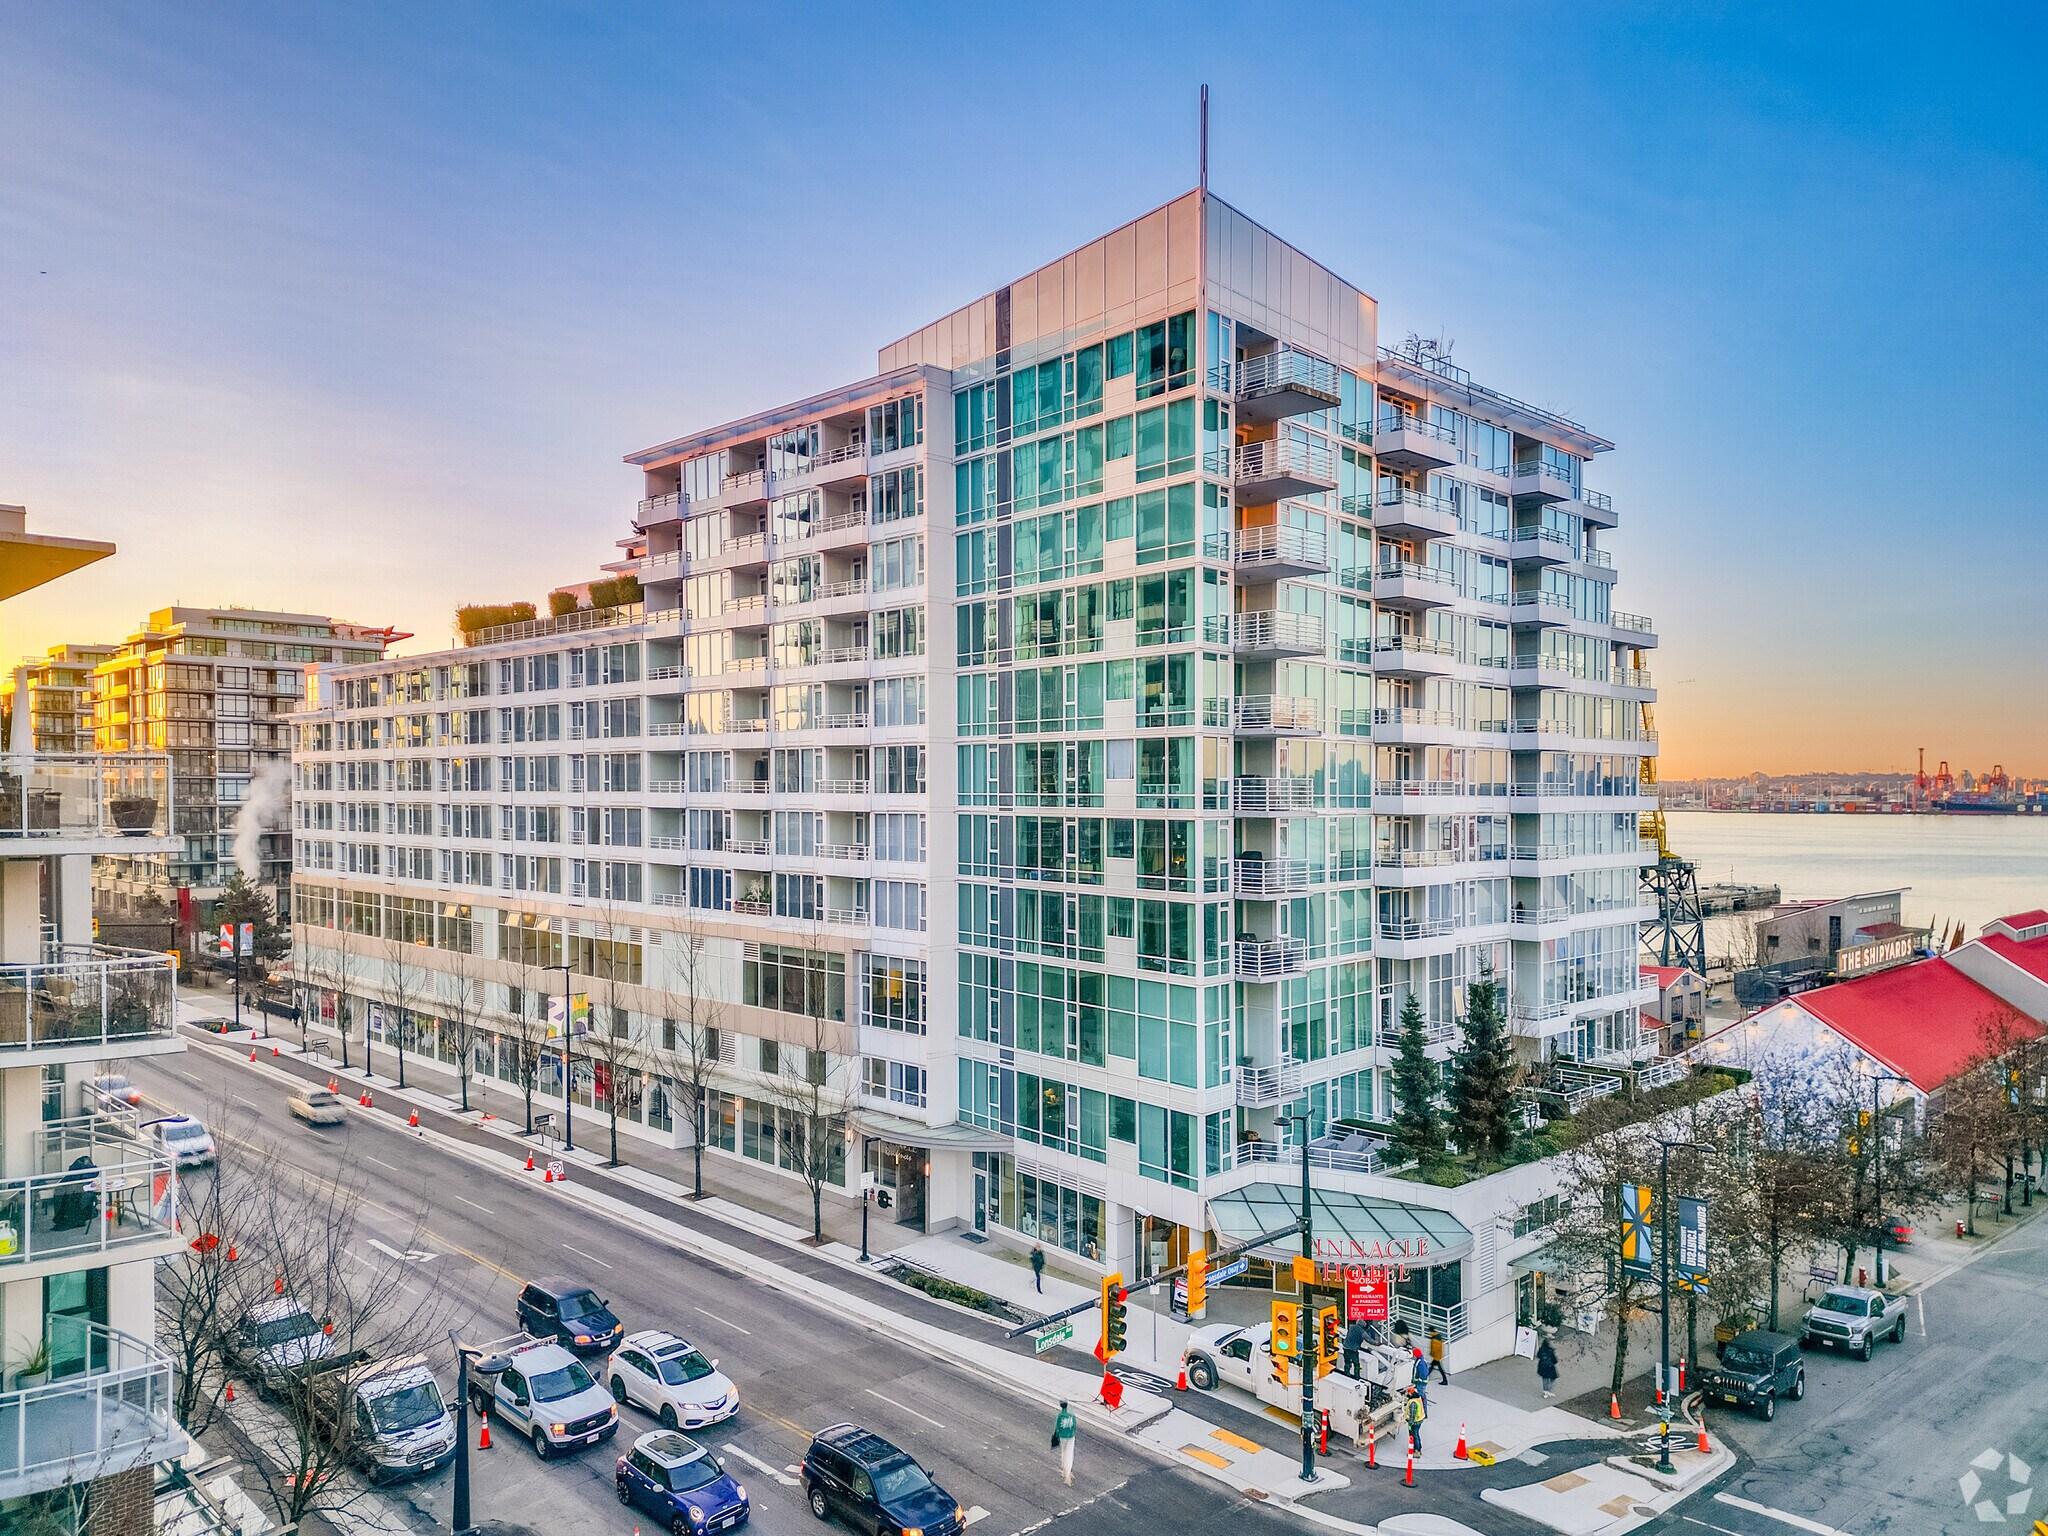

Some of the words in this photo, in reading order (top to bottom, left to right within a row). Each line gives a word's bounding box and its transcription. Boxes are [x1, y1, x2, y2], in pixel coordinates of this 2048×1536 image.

[1841, 950, 1861, 972] THE
[1863, 938, 1912, 967] SHIPYARDS
[1302, 1236, 1430, 1259] INNACLE
[1322, 1261, 1411, 1283] HOTEL
[1351, 1269, 1384, 1278] HTEL
[1037, 1331, 1066, 1352] Lonsdale
